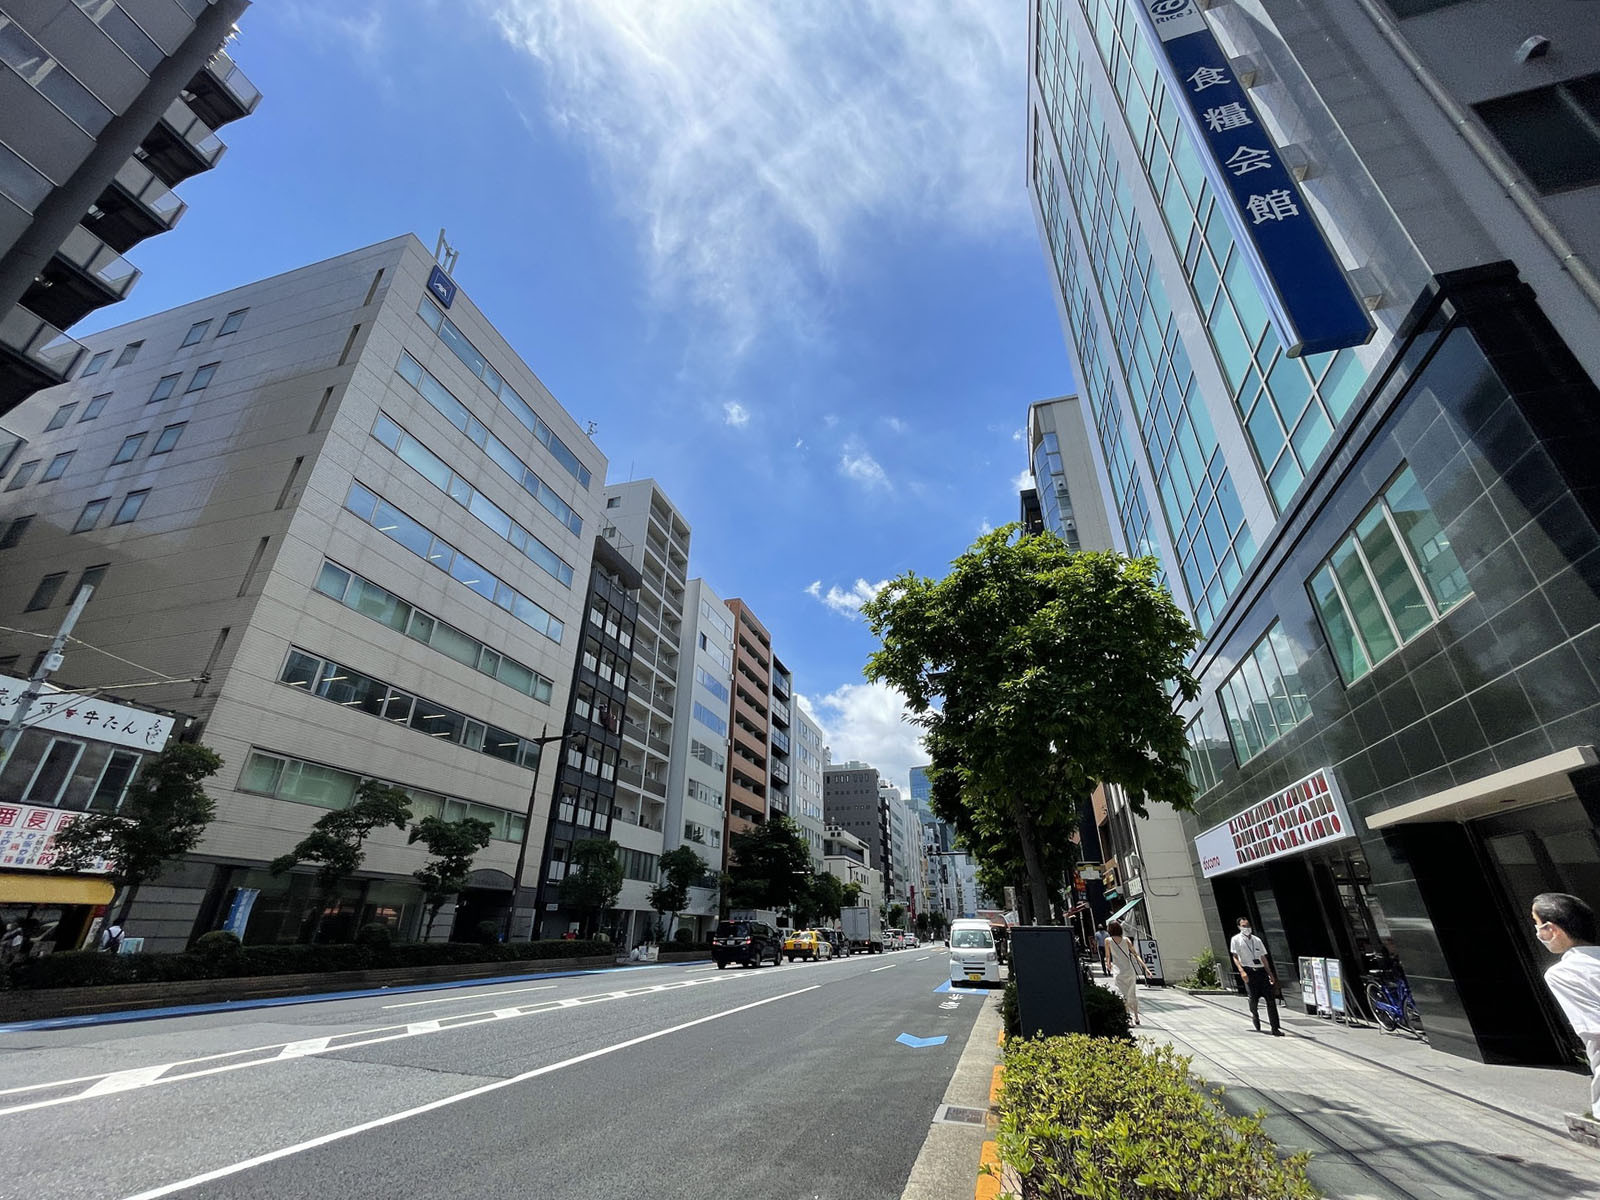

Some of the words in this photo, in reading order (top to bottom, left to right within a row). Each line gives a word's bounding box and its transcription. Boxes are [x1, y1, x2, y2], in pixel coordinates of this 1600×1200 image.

[1186, 66, 1299, 225] 食糧会館
[83, 710, 138, 734] 牛たん
[1203, 855, 1220, 870] docomo
